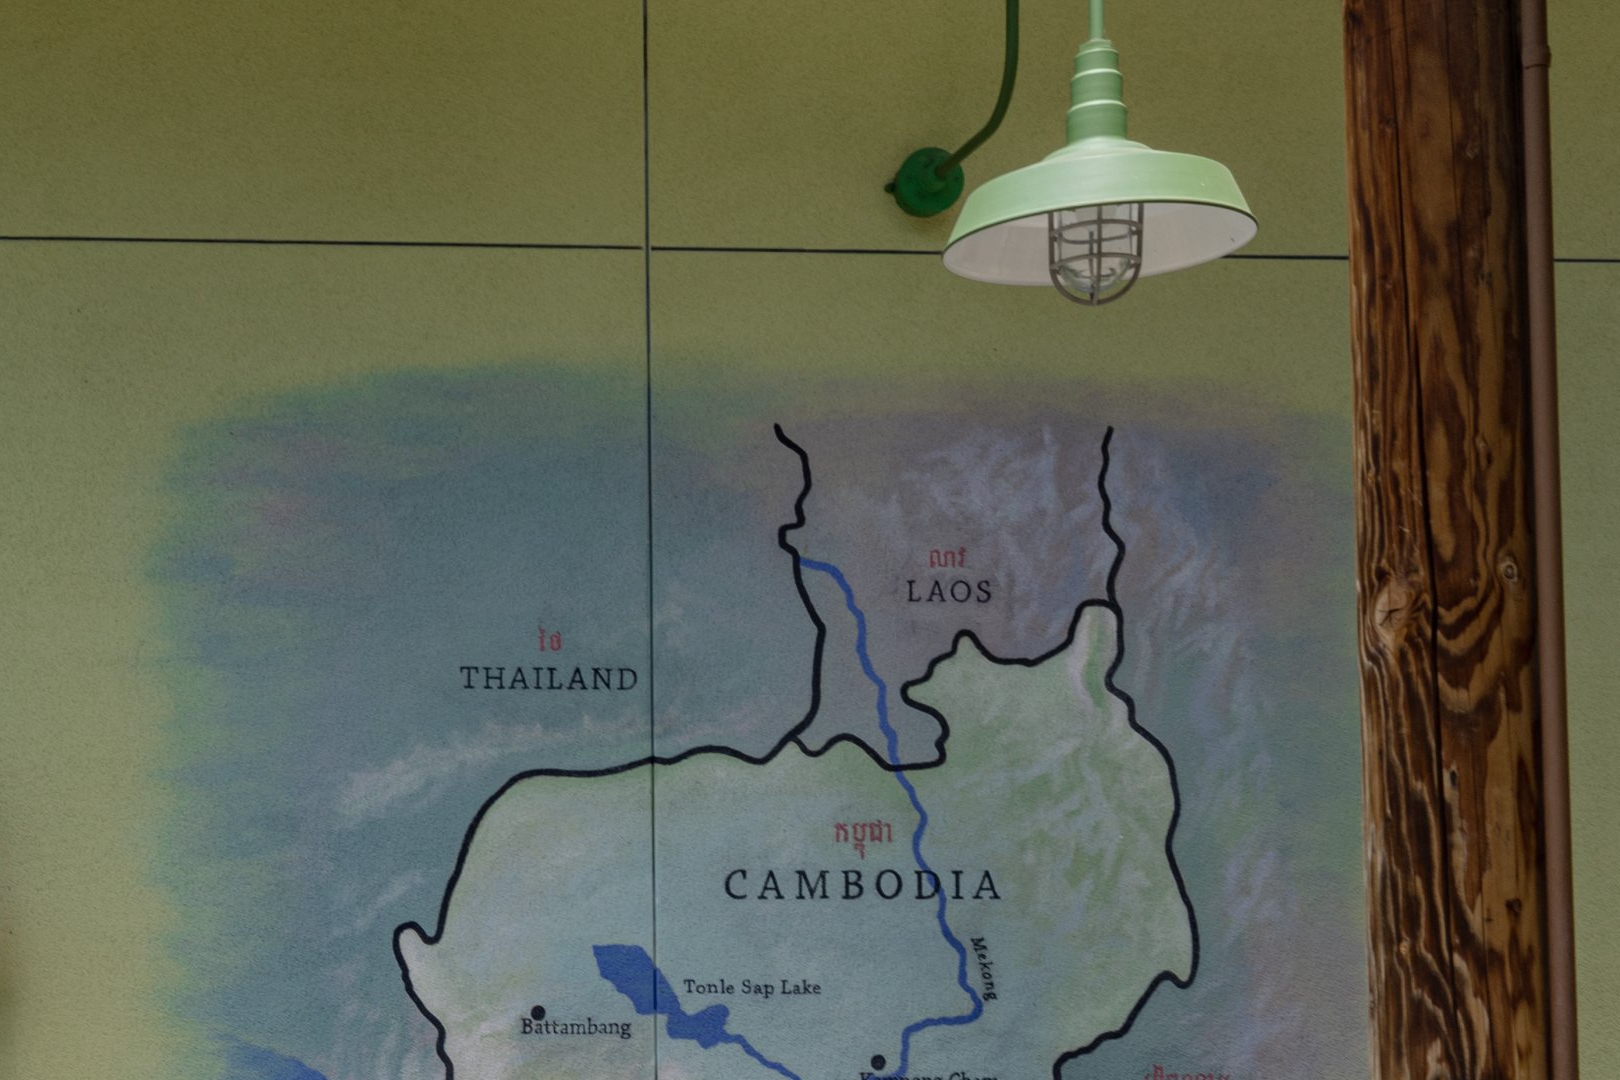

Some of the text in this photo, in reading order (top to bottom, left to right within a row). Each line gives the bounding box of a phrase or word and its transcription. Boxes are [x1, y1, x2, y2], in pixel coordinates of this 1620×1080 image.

[906, 580, 992, 603] LAOS
[460, 665, 638, 692] THAILAND
[724, 868, 1002, 901] CAMBODIA
[971, 937, 998, 1002] Mekong
[683, 979, 822, 998] Tonle Sap Lake
[521, 1018, 632, 1040] Battambang
